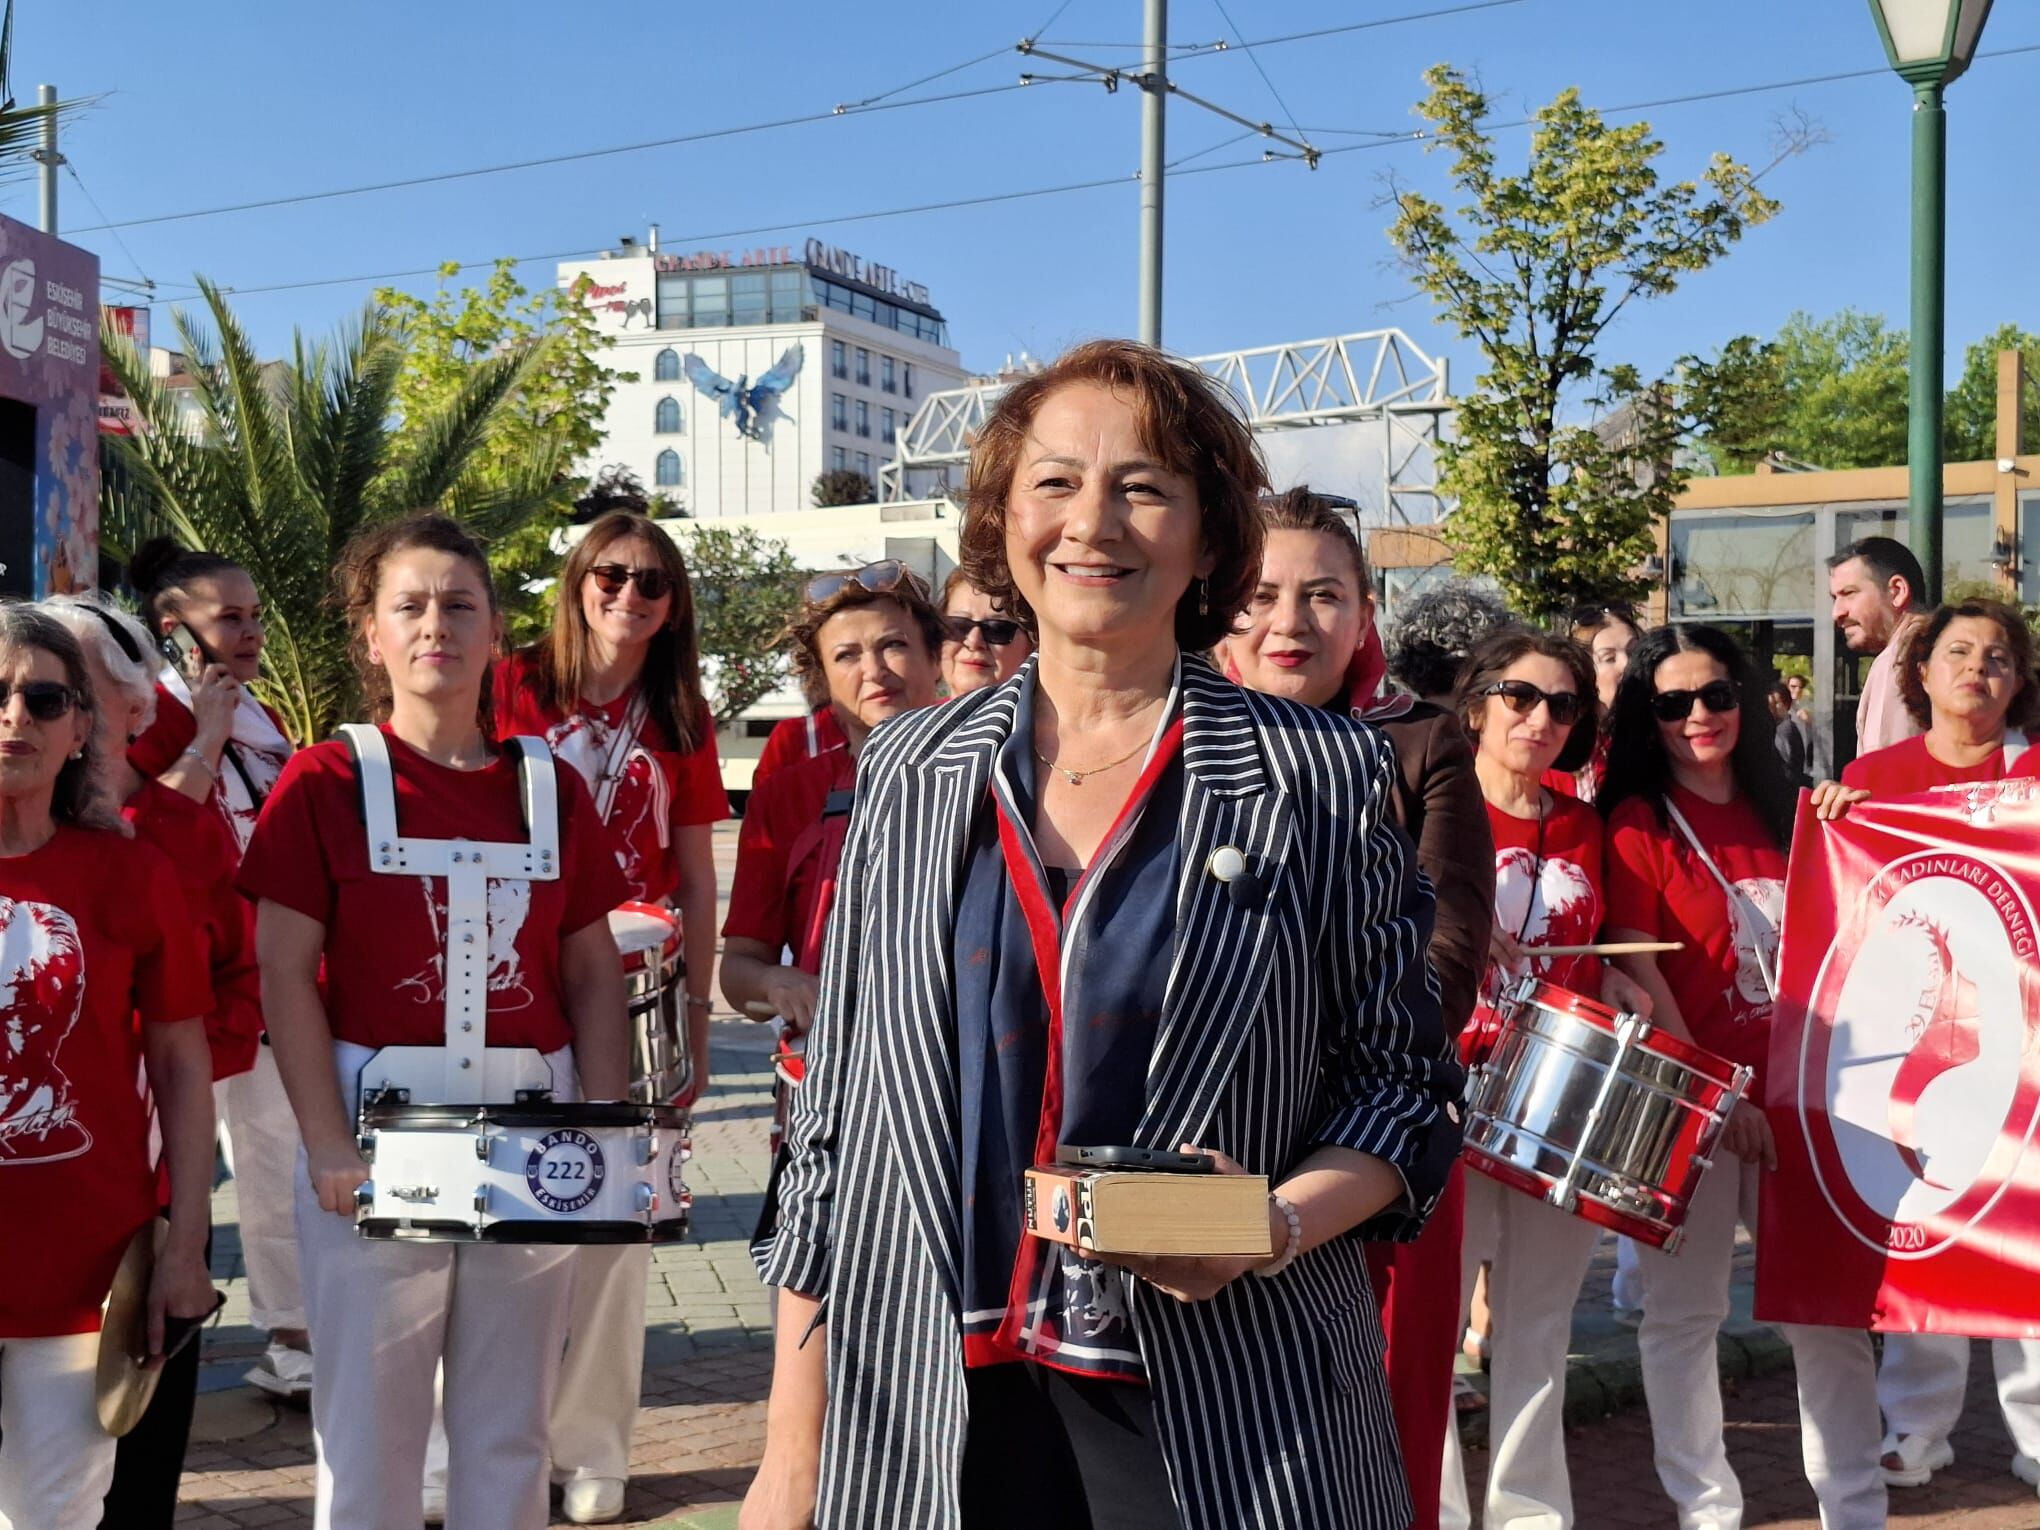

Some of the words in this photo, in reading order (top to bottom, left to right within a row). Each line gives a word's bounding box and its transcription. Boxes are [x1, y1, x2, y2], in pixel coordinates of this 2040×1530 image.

[655, 250, 733, 272] GRANDE
[742, 246, 793, 267] ARTE
[804, 237, 861, 281] GRANDE
[534, 1131, 599, 1155] BANDO
[547, 1161, 586, 1180] 222
[1886, 1224, 1926, 1249] 2020
